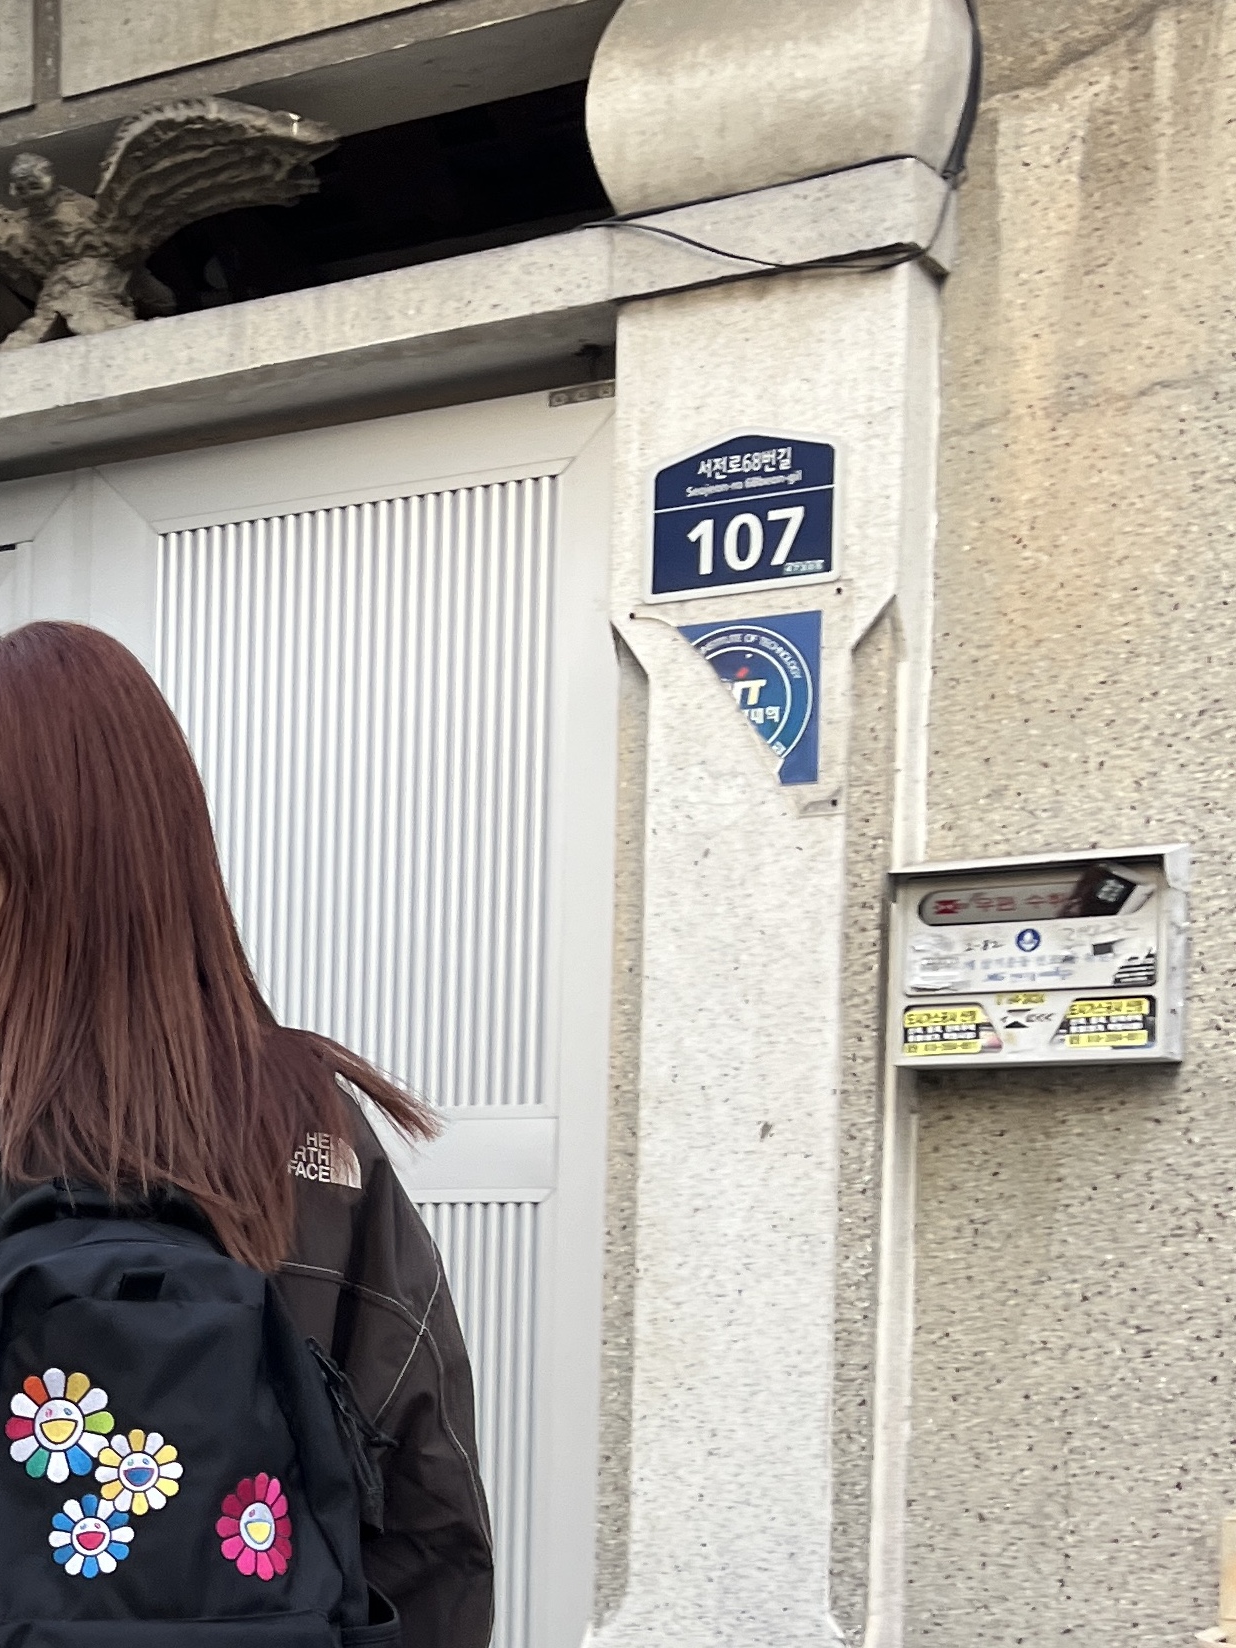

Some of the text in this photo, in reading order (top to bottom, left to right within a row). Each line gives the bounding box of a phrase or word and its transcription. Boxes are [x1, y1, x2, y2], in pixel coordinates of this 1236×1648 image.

[697, 447, 792, 479] 서전로68번길
[687, 506, 805, 576] 107
[306, 1131, 330, 1149] HE
[288, 1159, 330, 1183] FACE
